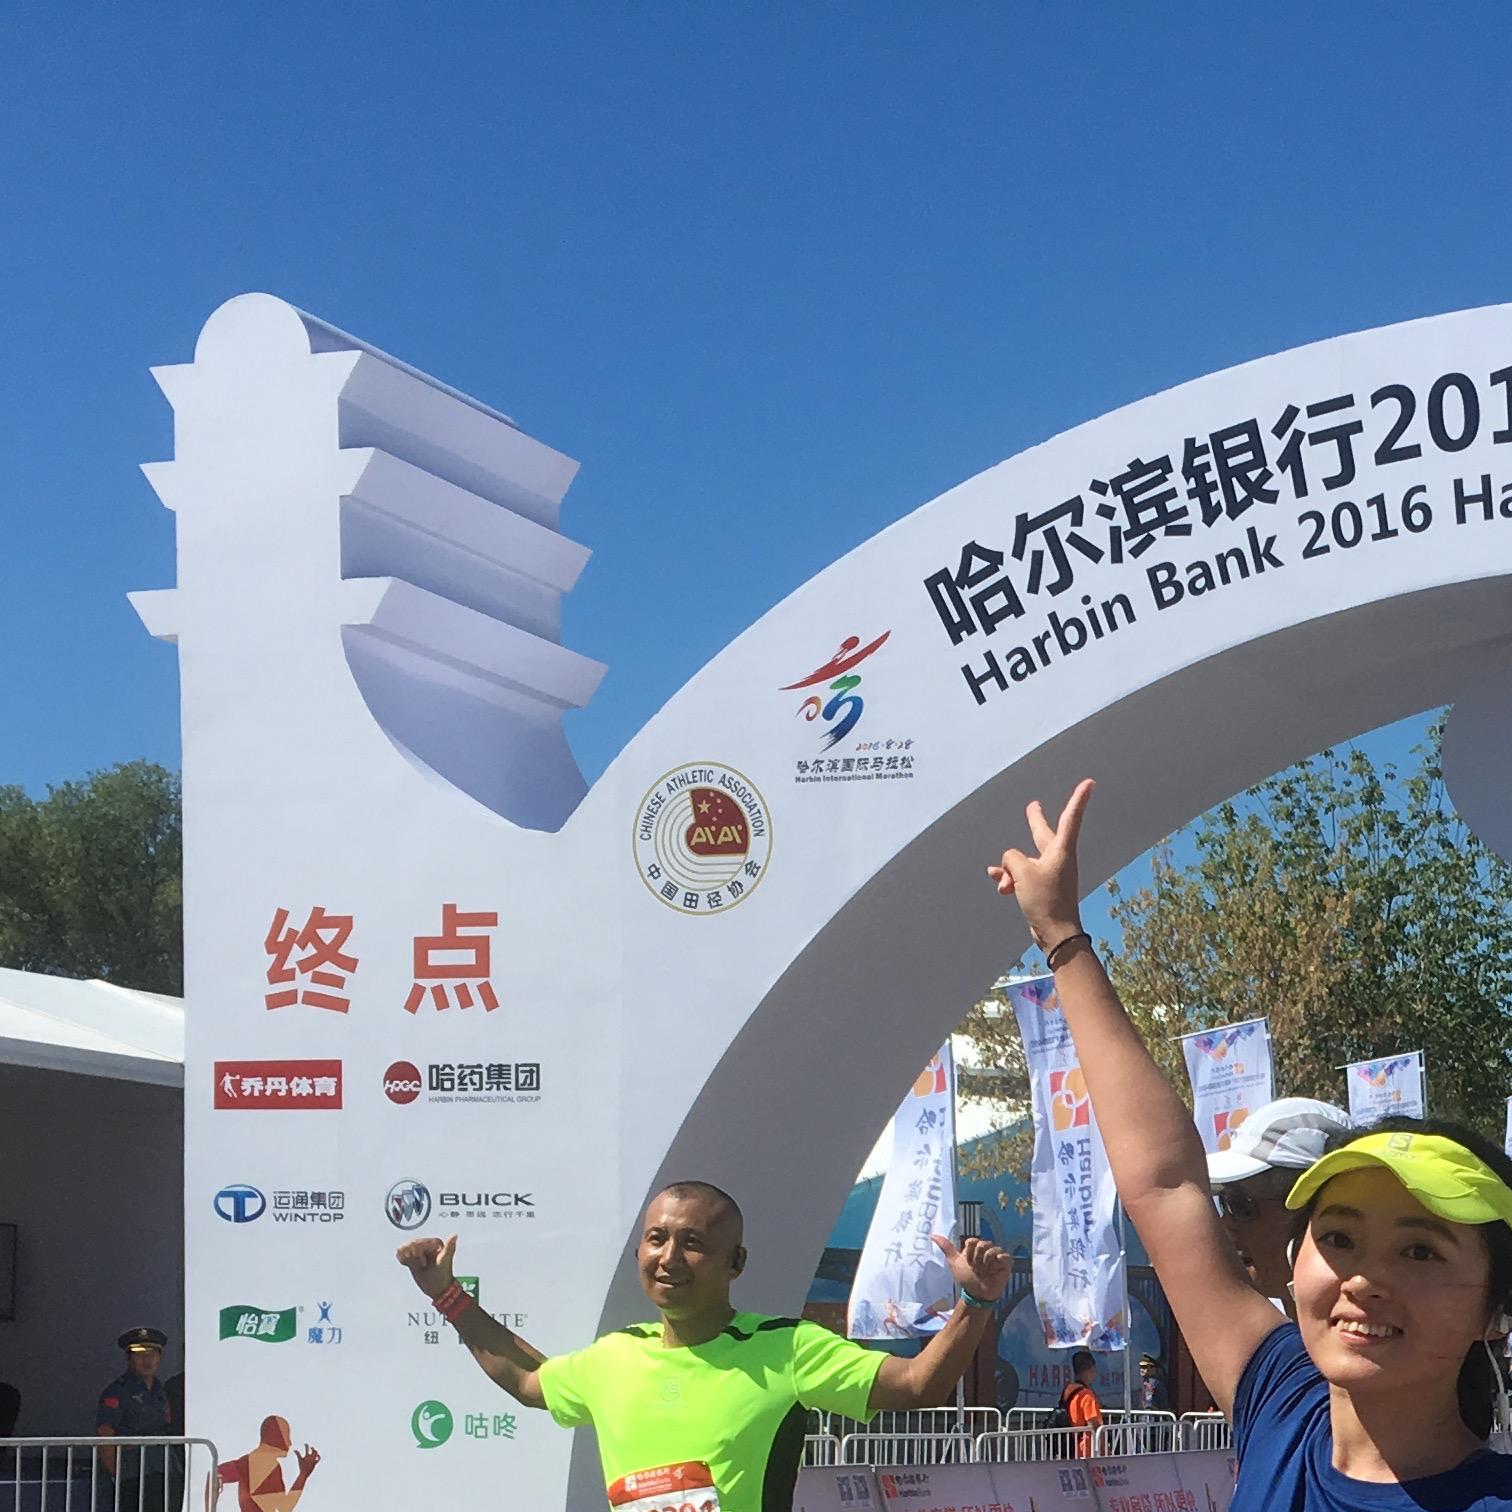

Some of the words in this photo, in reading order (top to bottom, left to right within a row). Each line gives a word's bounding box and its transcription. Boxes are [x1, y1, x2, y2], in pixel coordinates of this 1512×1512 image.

[961, 590, 1137, 706] Harbin
[1146, 526, 1285, 611] Bank
[1297, 484, 1434, 559] 2016
[795, 775, 822, 783] Harbin
[875, 772, 914, 780] Marathon
[640, 792, 666, 841] CHINESE
[666, 769, 714, 795] ATHLETIC
[718, 773, 765, 838] ASSOCIATION
[647, 860, 761, 909] 中国田径协会
[241, 1076, 338, 1097] 乔丹体育
[428, 1063, 541, 1092] 哈药集团
[273, 1190, 345, 1210] 运通集团
[440, 1193, 535, 1206] BUICK
[273, 1213, 345, 1224] WINTOP
[308, 1326, 342, 1345] 魔力
[465, 1412, 518, 1440] 咕咚
